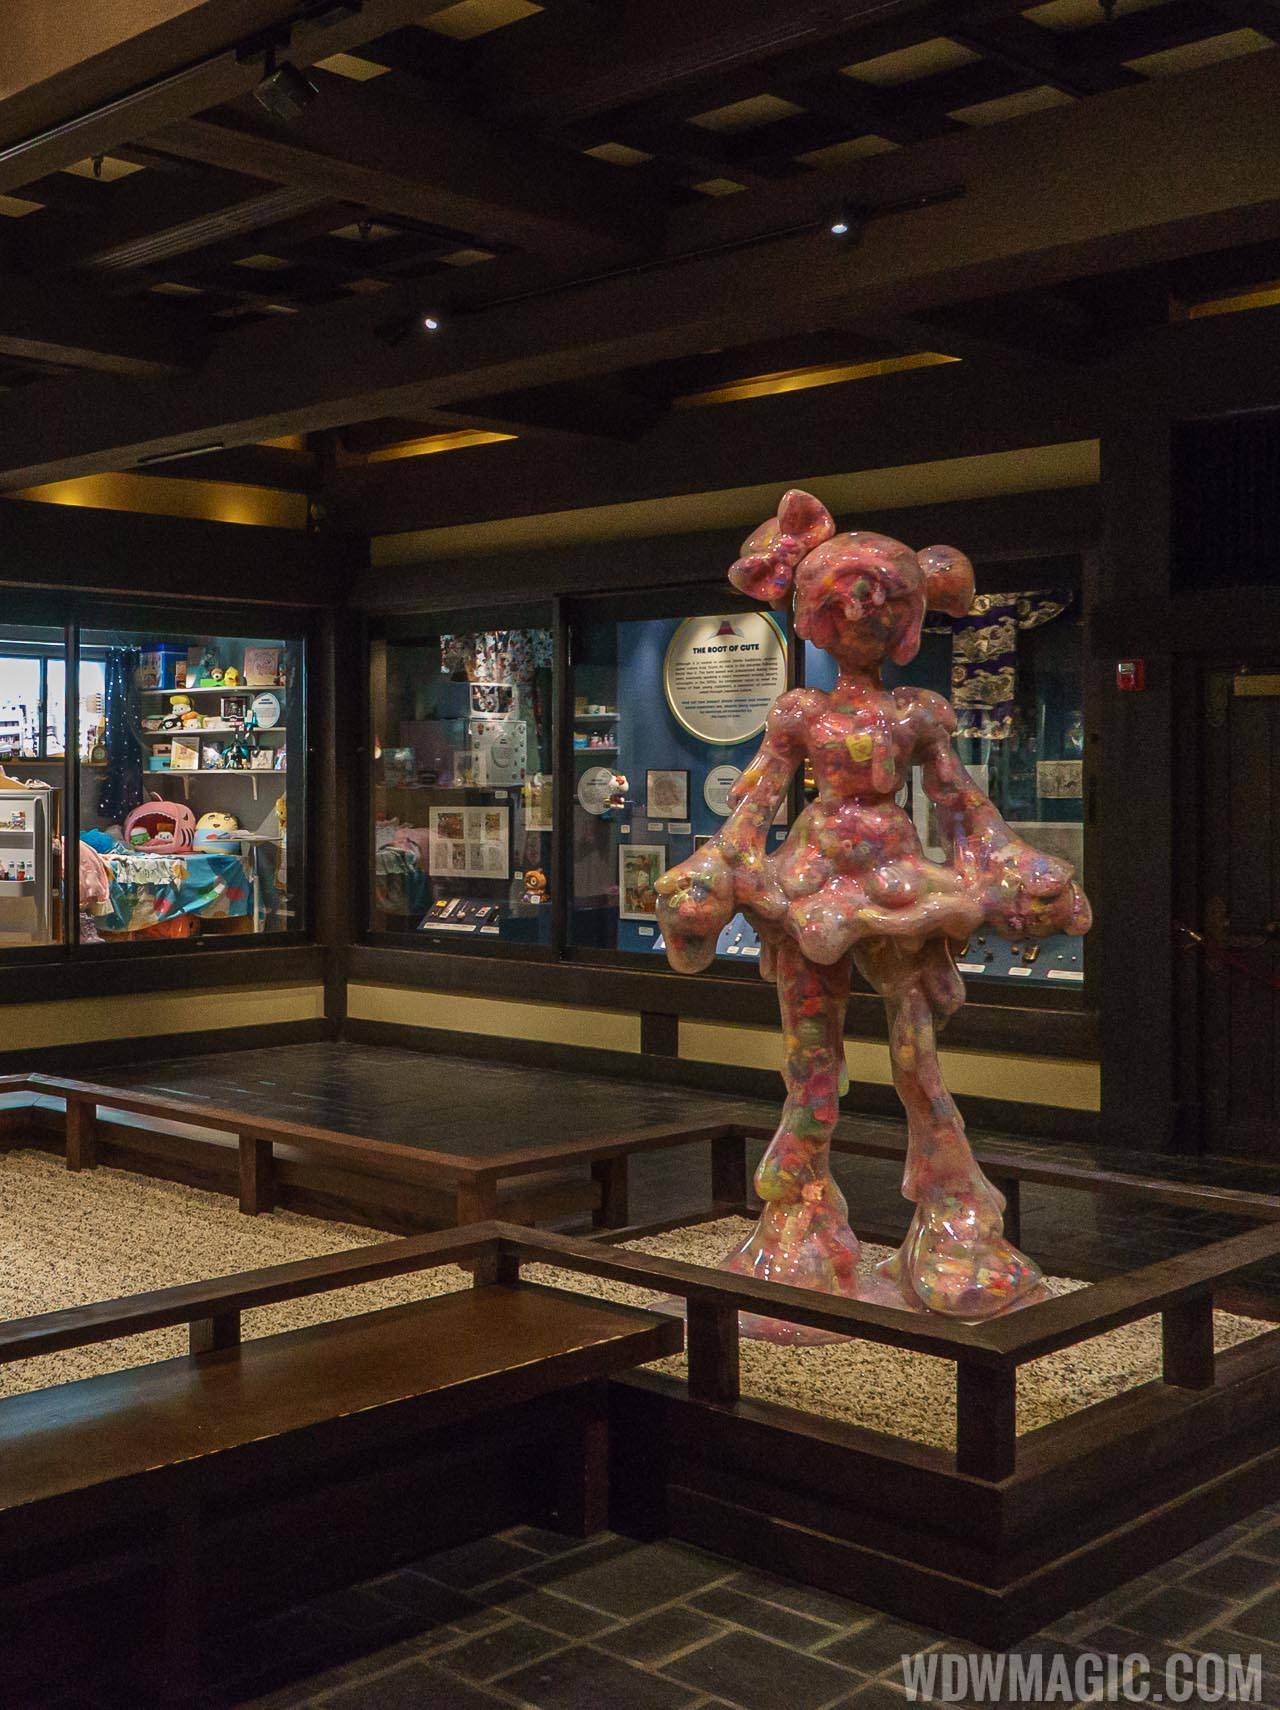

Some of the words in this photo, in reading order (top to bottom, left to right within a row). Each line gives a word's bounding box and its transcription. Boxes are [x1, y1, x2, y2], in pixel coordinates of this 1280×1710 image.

[707, 645, 728, 653] ROOT
[729, 644, 739, 652] OF
[740, 643, 760, 651] CUTE
